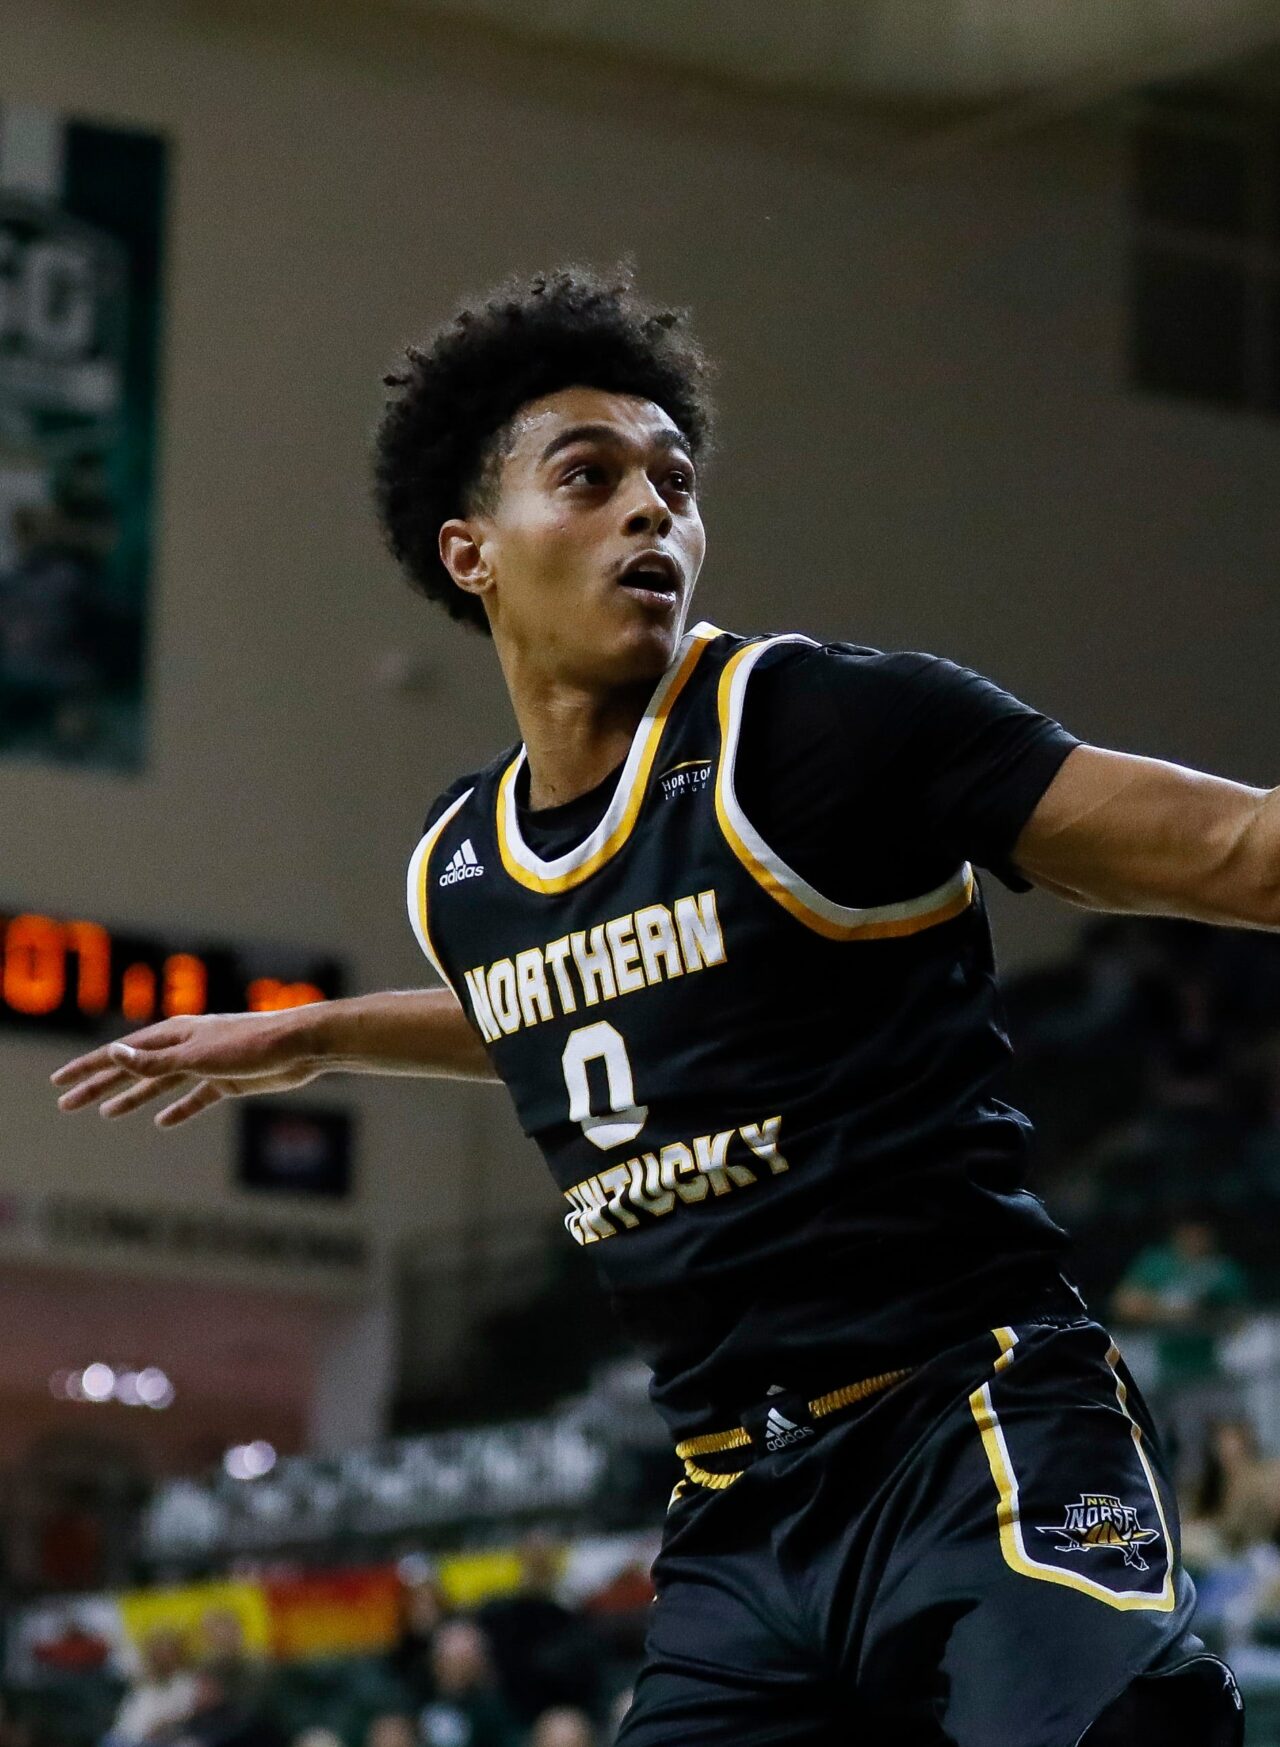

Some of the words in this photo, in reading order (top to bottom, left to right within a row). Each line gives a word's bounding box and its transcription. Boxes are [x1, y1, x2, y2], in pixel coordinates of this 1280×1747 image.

[439, 864, 485, 887] adidas
[464, 888, 728, 1044] NORTHERN
[561, 1020, 649, 1151] 0
[766, 1426, 815, 1451] adidas
[1086, 1497, 1121, 1508] NKU
[1069, 1507, 1137, 1532] NORSE
